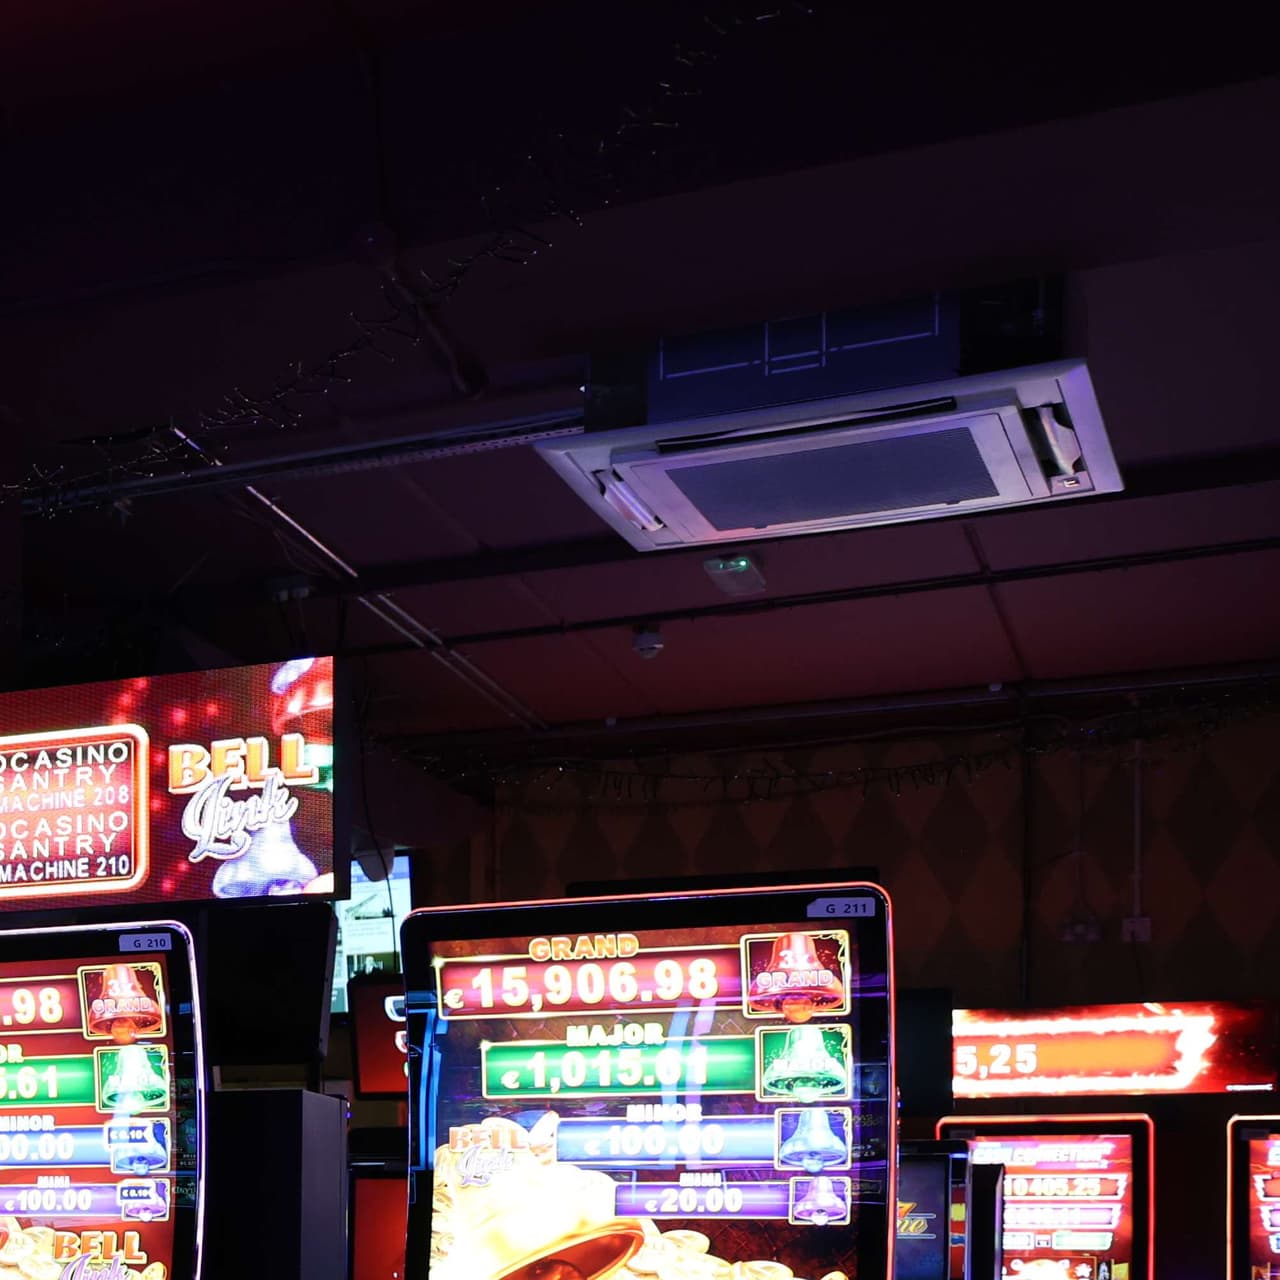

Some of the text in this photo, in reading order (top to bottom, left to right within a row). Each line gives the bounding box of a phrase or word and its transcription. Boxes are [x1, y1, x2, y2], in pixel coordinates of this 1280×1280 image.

[168, 733, 319, 795] BELL
[93, 785, 129, 806] 208
[181, 767, 299, 863] Link
[96, 854, 129, 876] 210
[825, 902, 867, 914] G 211
[134, 938, 166, 949] G 210
[529, 934, 640, 963] GRAND
[756, 970, 834, 989] GRAND
[566, 1023, 665, 1047] MAJOR
[627, 1103, 703, 1122] MINOR
[448, 1127, 527, 1151] BELL
[53, 1231, 147, 1264] BELL
